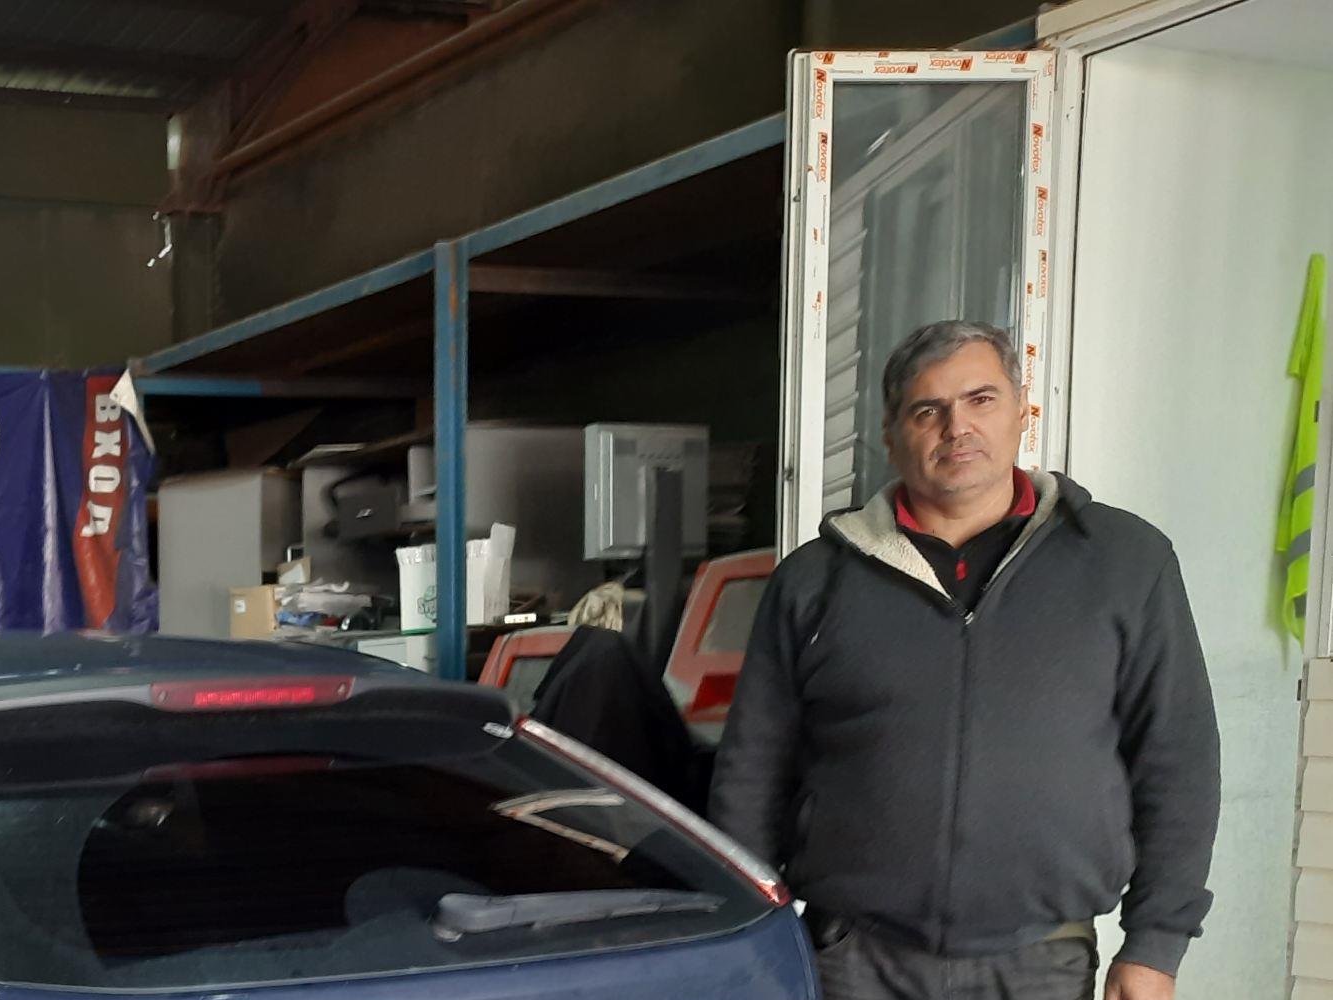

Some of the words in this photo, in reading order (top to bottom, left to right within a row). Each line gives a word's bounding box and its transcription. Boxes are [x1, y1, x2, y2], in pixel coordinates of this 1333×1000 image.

[929, 56, 972, 71] Novotex
[816, 68, 827, 119] Novotex
[1032, 122, 1044, 174] Novotex
